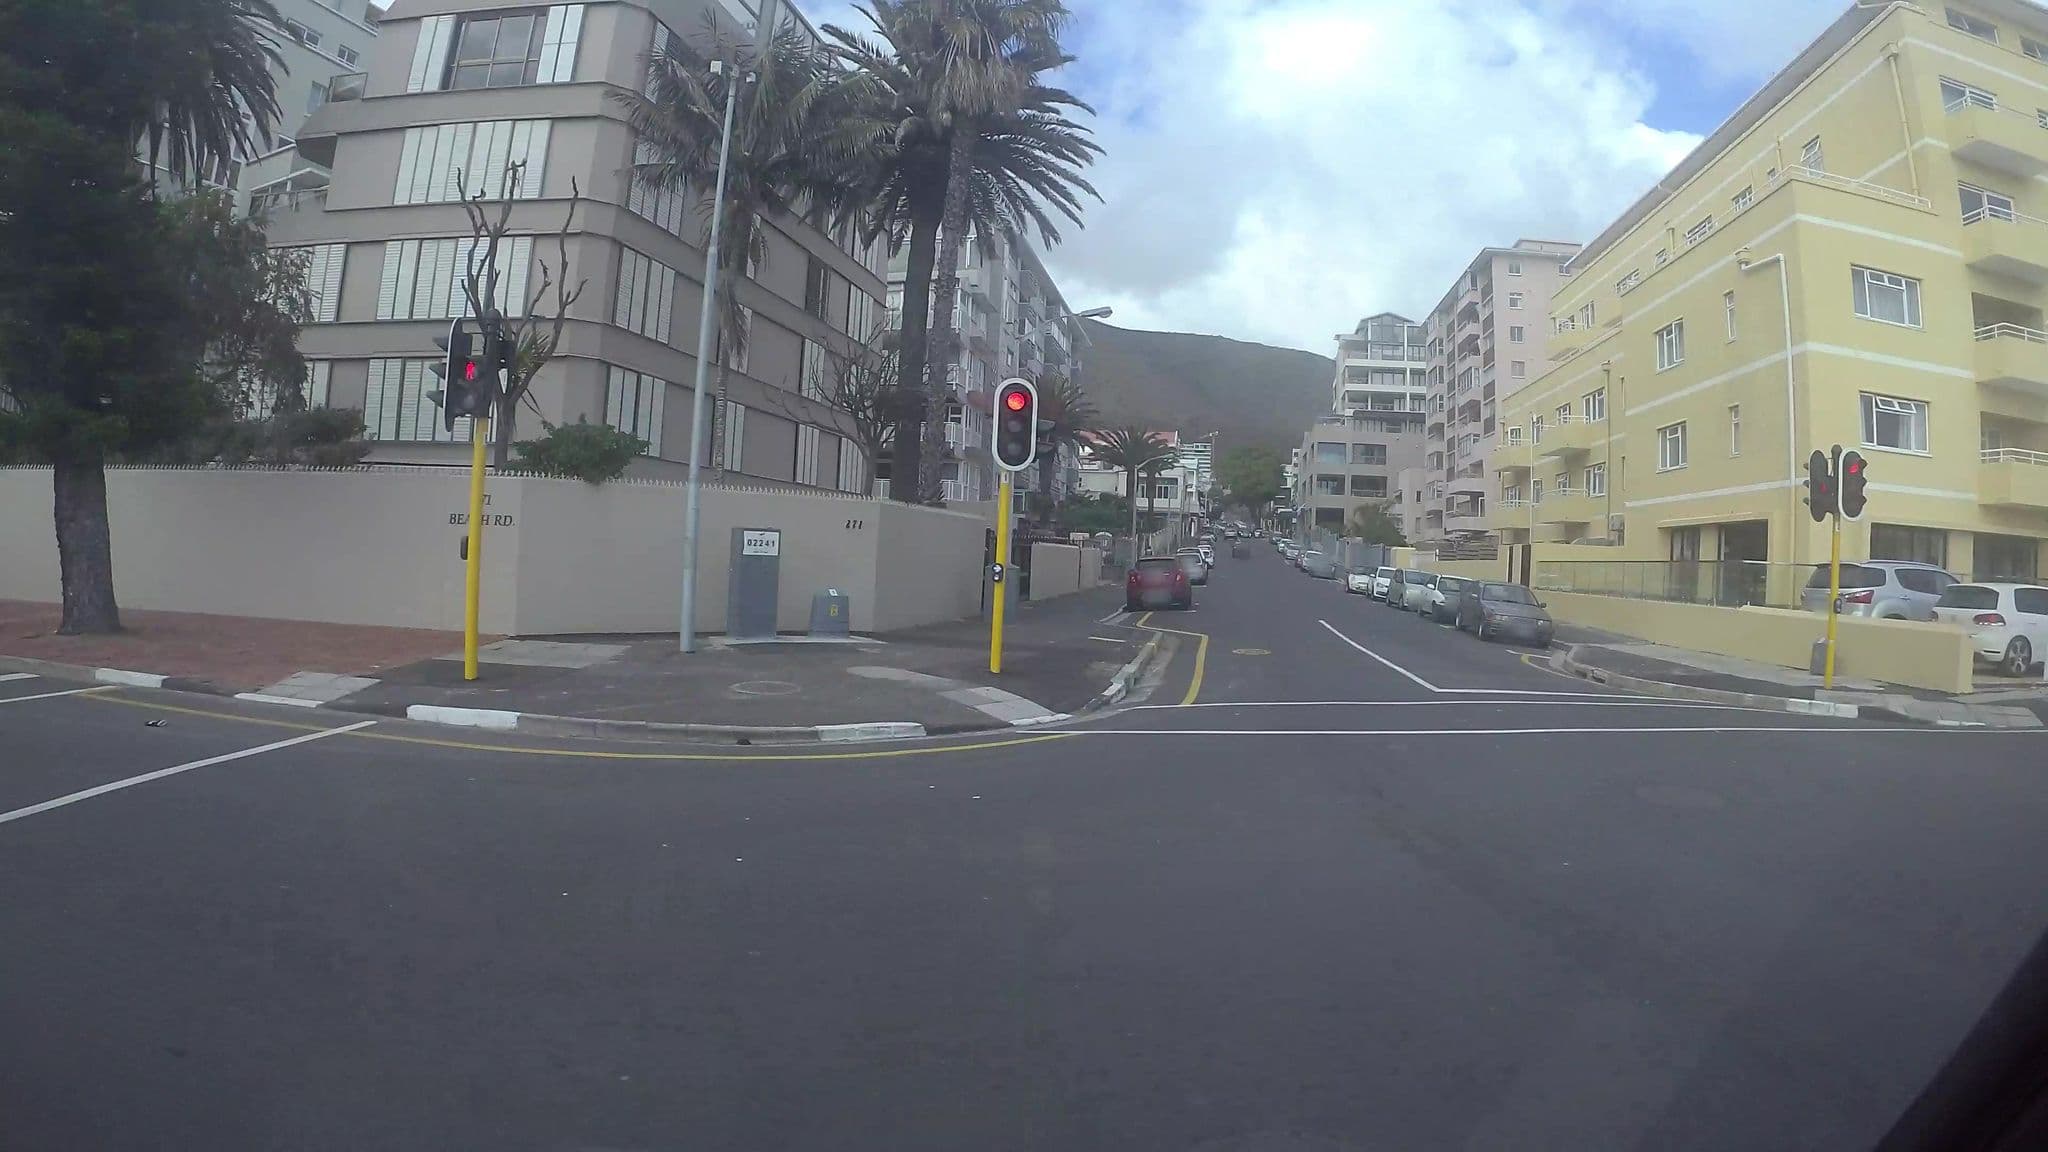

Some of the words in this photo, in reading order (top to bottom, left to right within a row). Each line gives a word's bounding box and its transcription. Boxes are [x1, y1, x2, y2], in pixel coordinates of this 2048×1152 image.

[449, 513, 490, 526] BEAH
[494, 514, 515, 527] RD.
[747, 539, 775, 547] 02241
